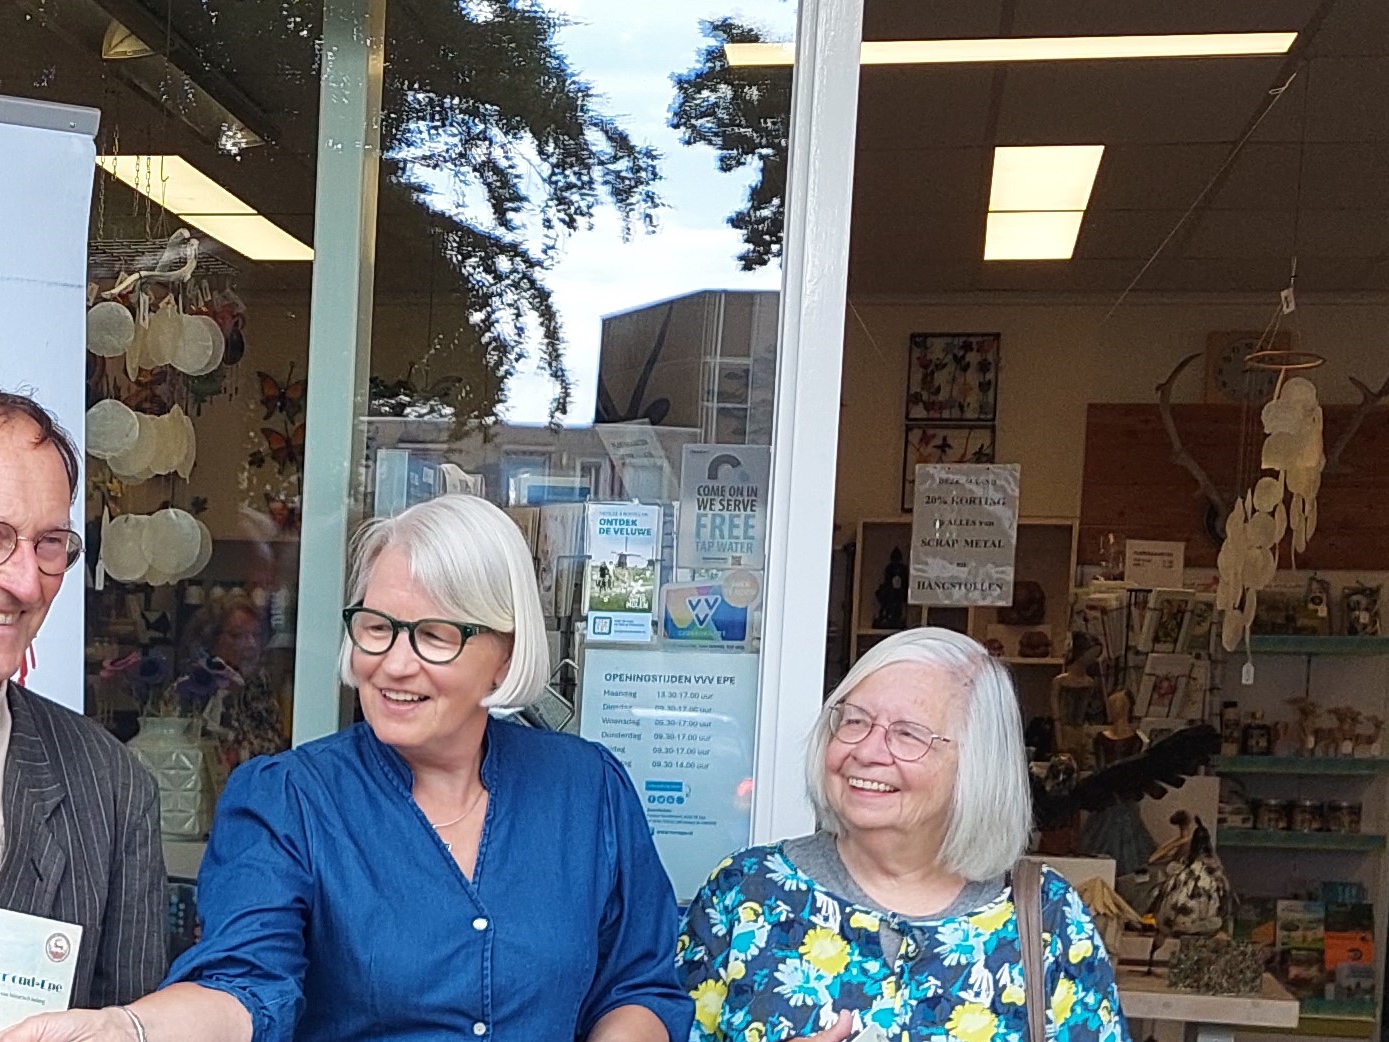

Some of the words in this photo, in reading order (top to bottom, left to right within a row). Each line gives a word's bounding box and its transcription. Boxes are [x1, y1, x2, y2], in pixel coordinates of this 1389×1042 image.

[697, 484, 726, 498] COME
[729, 485, 744, 498] ON
[747, 485, 758, 498] IN
[697, 498, 716, 512] WE
[718, 498, 757, 512] SERVE
[925, 495, 948, 505] 20%
[951, 495, 1006, 506] KORTING
[599, 518, 638, 527] ONTDEK
[696, 513, 756, 541] FREE
[947, 519, 976, 527] ALLES
[599, 527, 611, 535] DE
[613, 527, 652, 536] VELUWE
[696, 541, 717, 553] TAP
[718, 541, 753, 554] WATER
[920, 538, 959, 548] SCRAP
[963, 539, 1005, 549] METAL
[604, 673, 692, 684] OPENINGSTIJDEN
[693, 675, 714, 684] VVV
[717, 676, 736, 685] EPE
[11, 975, 63, 993] oud-Epe
